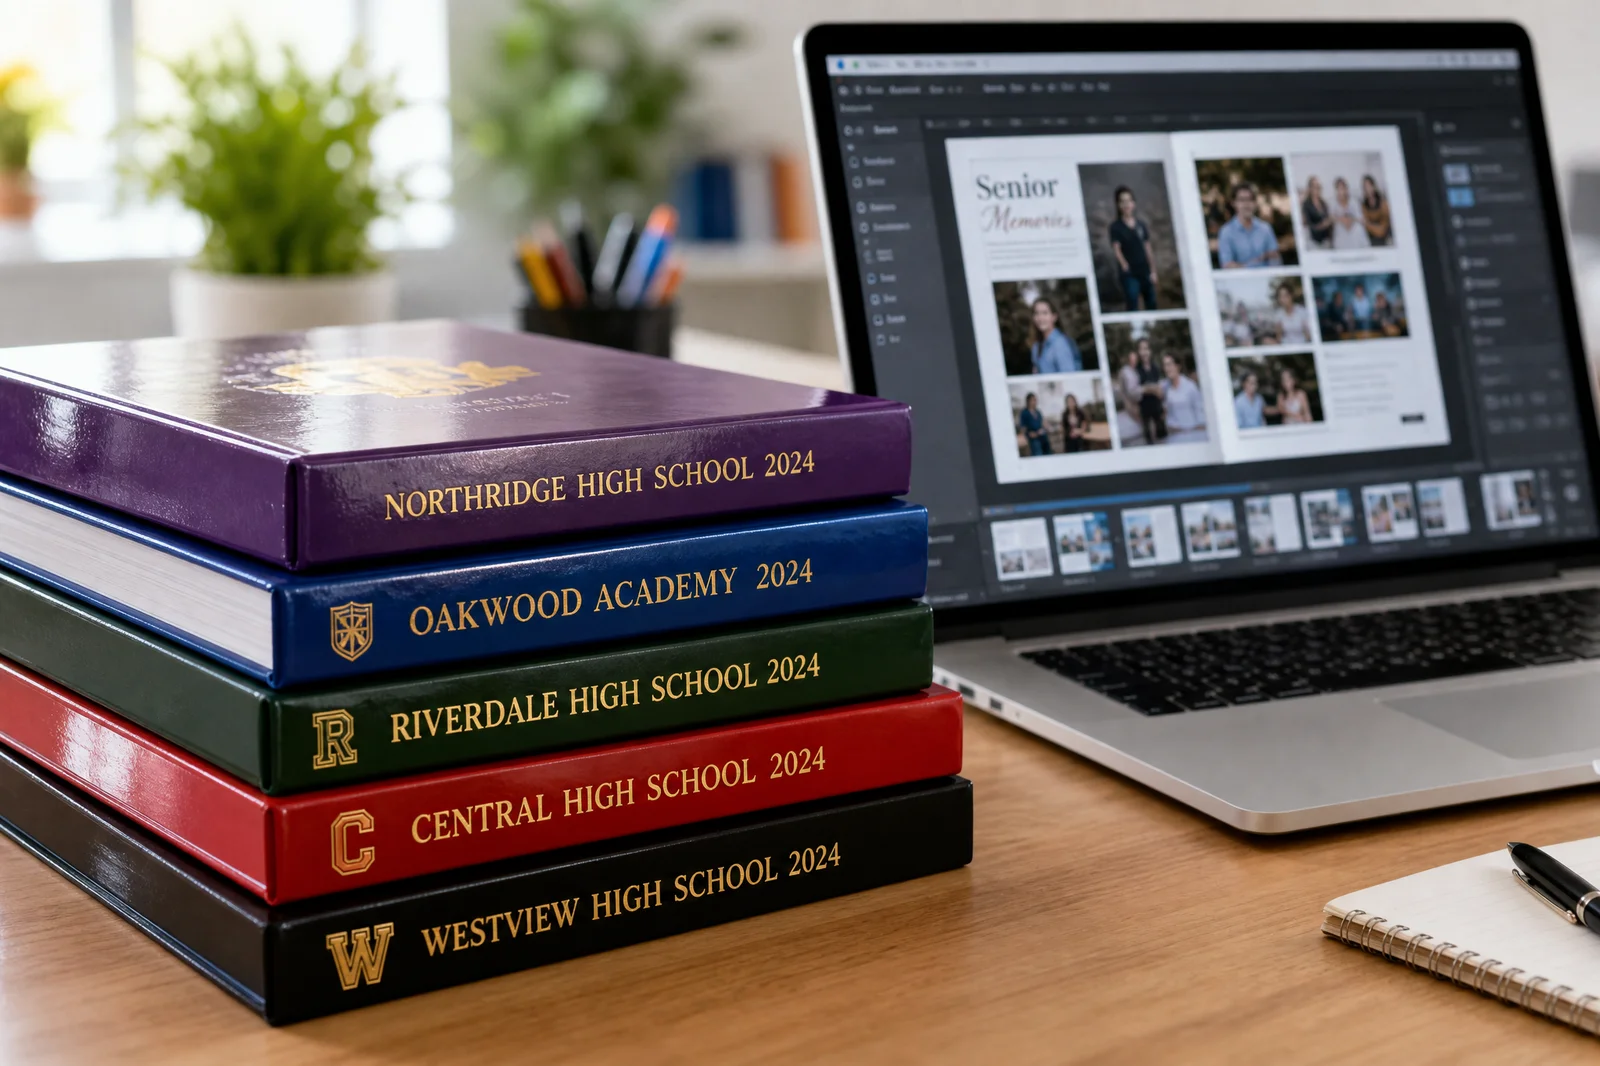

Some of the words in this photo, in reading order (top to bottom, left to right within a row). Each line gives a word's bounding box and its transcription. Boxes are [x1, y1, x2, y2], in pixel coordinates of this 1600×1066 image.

[976, 173, 1058, 200] Senior
[981, 204, 1073, 233] Memories
[384, 476, 567, 520] NORTHRIDGE
[577, 467, 643, 499] HIGH
[654, 456, 754, 490] SCHOOL
[764, 450, 815, 478] 2024
[409, 587, 582, 636] OAKWOOD
[594, 567, 737, 613] ACADEMY
[757, 558, 813, 590] 2024
[391, 691, 559, 743] RIVERDALE
[569, 679, 640, 715] HIGH
[651, 662, 758, 702] SCHOOL
[767, 652, 820, 684] 2024
[312, 708, 358, 770] R
[411, 793, 553, 844] CENTRAL
[563, 778, 635, 817] HIGH
[646, 758, 757, 801] SCHOOL
[770, 745, 826, 779] 2024
[330, 808, 375, 876] C
[421, 897, 581, 956] WESTVIEW
[592, 879, 663, 921] HIGH
[674, 856, 779, 902] SCHOOL
[788, 841, 841, 877] 2024
[326, 921, 394, 991] W
